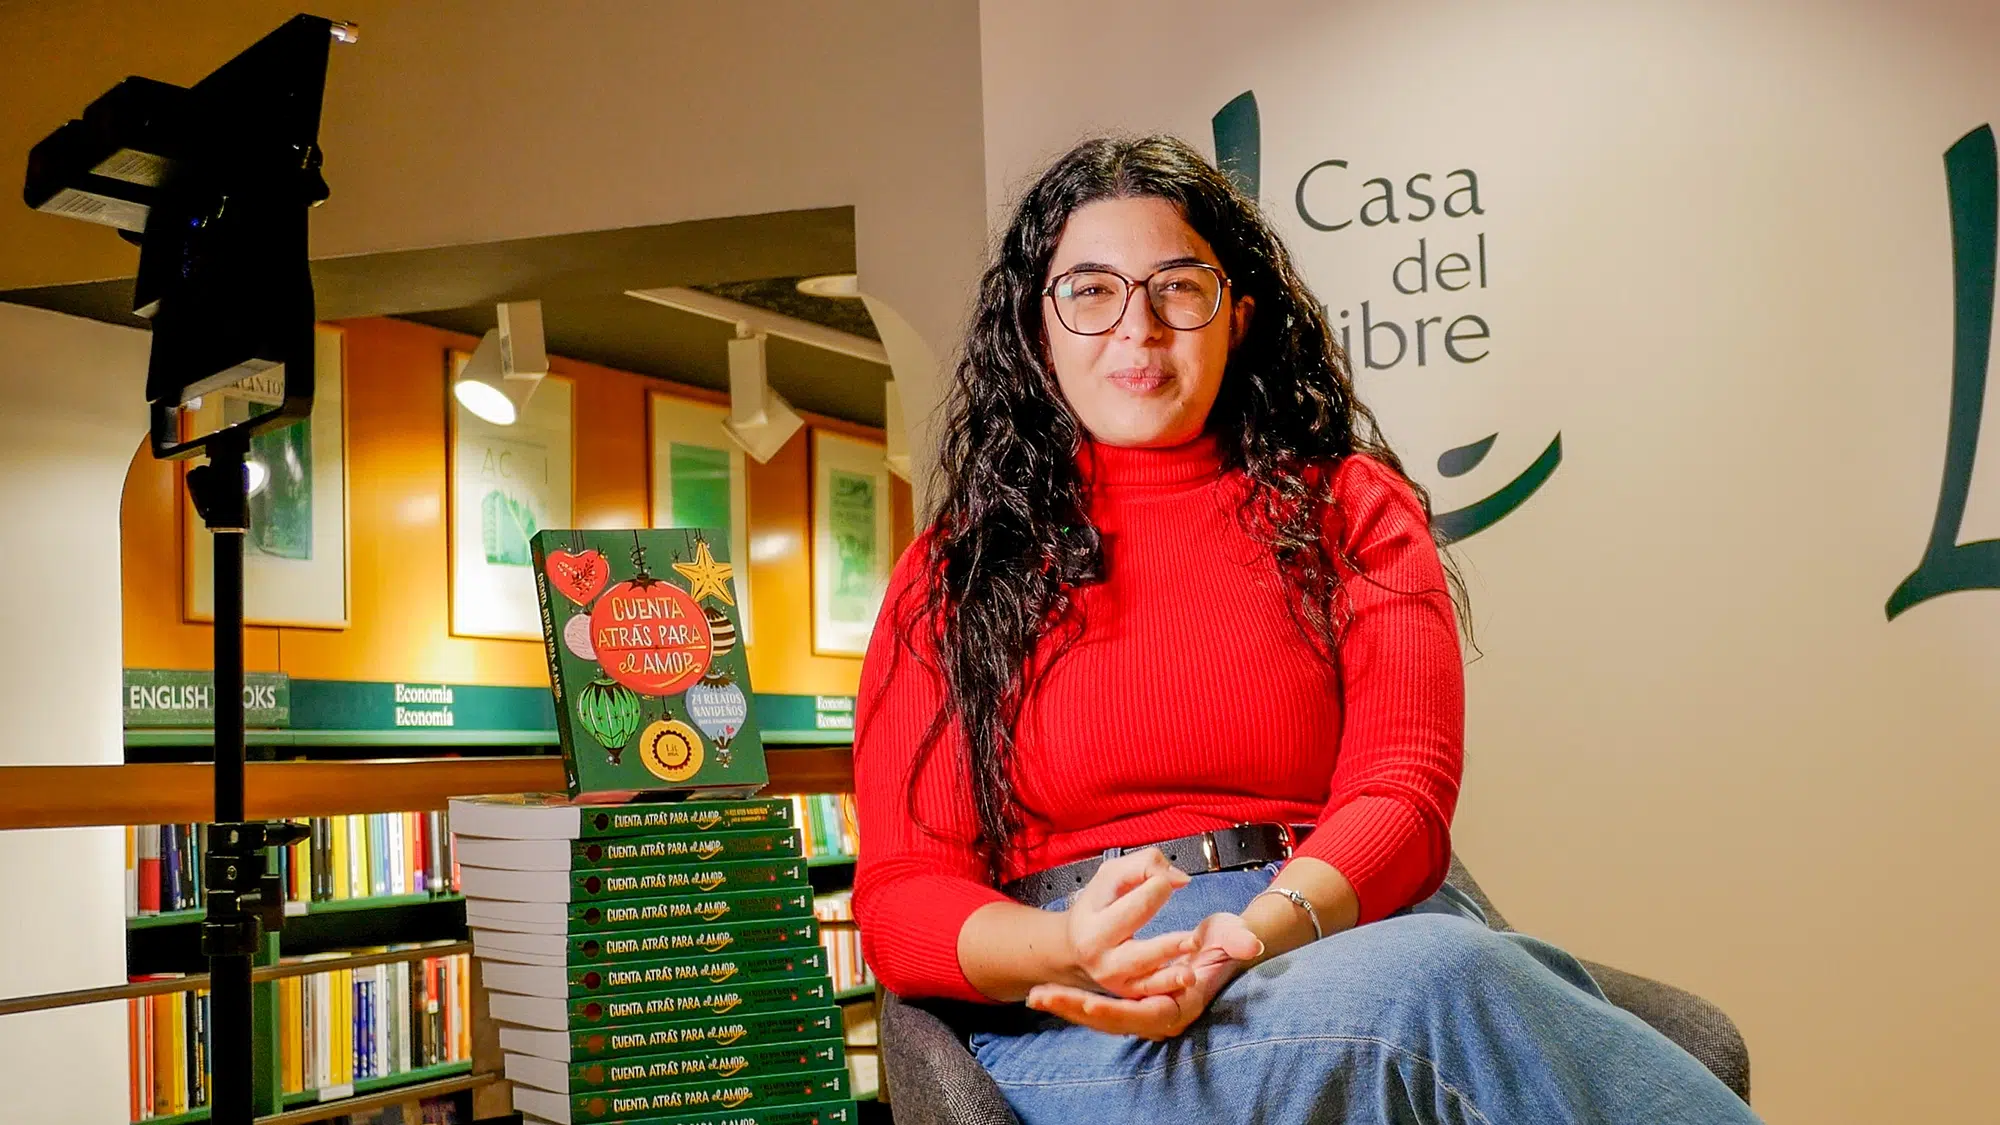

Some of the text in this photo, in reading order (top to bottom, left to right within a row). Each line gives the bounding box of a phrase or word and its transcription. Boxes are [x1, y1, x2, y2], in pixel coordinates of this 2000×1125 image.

[1295, 159, 1486, 232] Casa
[1392, 232, 1488, 295] del
[611, 597, 685, 621] CUENTA
[598, 624, 704, 648] ATRÁS PARA
[619, 652, 702, 675] el AMOR
[130, 685, 276, 709] ENGLISH OKS
[395, 684, 453, 704] Economía
[703, 692, 742, 704] RELATOS
[395, 706, 454, 727] Economía
[693, 705, 744, 717] NAVIDEÑOS
[615, 815, 642, 828] CUENTA
[644, 811, 668, 825] ATRÁS
[670, 811, 689, 823] PARA
[608, 845, 637, 859] CUENTA
[641, 842, 665, 856] ATRÁS
[667, 842, 687, 854] PARA
[608, 877, 638, 890] CUENTA
[641, 873, 665, 888] ATRÁS
[668, 873, 689, 886] PARA
[607, 908, 638, 922] CUENTA
[642, 904, 668, 919] ATRÁS
[671, 904, 691, 916] PARA
[607, 940, 639, 954] CUENTA
[642, 936, 669, 950] ATRÁS
[672, 936, 693, 948] PARA
[609, 972, 643, 985] CUENTA
[645, 967, 672, 982] ATRÁS
[675, 967, 698, 979] PARA
[610, 1004, 643, 1017] CUENTA
[647, 999, 674, 1013] ATRÁS
[677, 997, 700, 1009] PARA
[612, 1035, 646, 1049] CUENTA
[650, 1029, 678, 1044] ATRÁS
[681, 1028, 705, 1040] PARA
[611, 1067, 646, 1081] CUENTA
[649, 1062, 678, 1077] ATRÁS
[682, 1060, 705, 1072] PARA
[614, 1099, 649, 1112] CUENTA
[652, 1094, 681, 1108] ATRÁS
[685, 1091, 709, 1104] PARA
